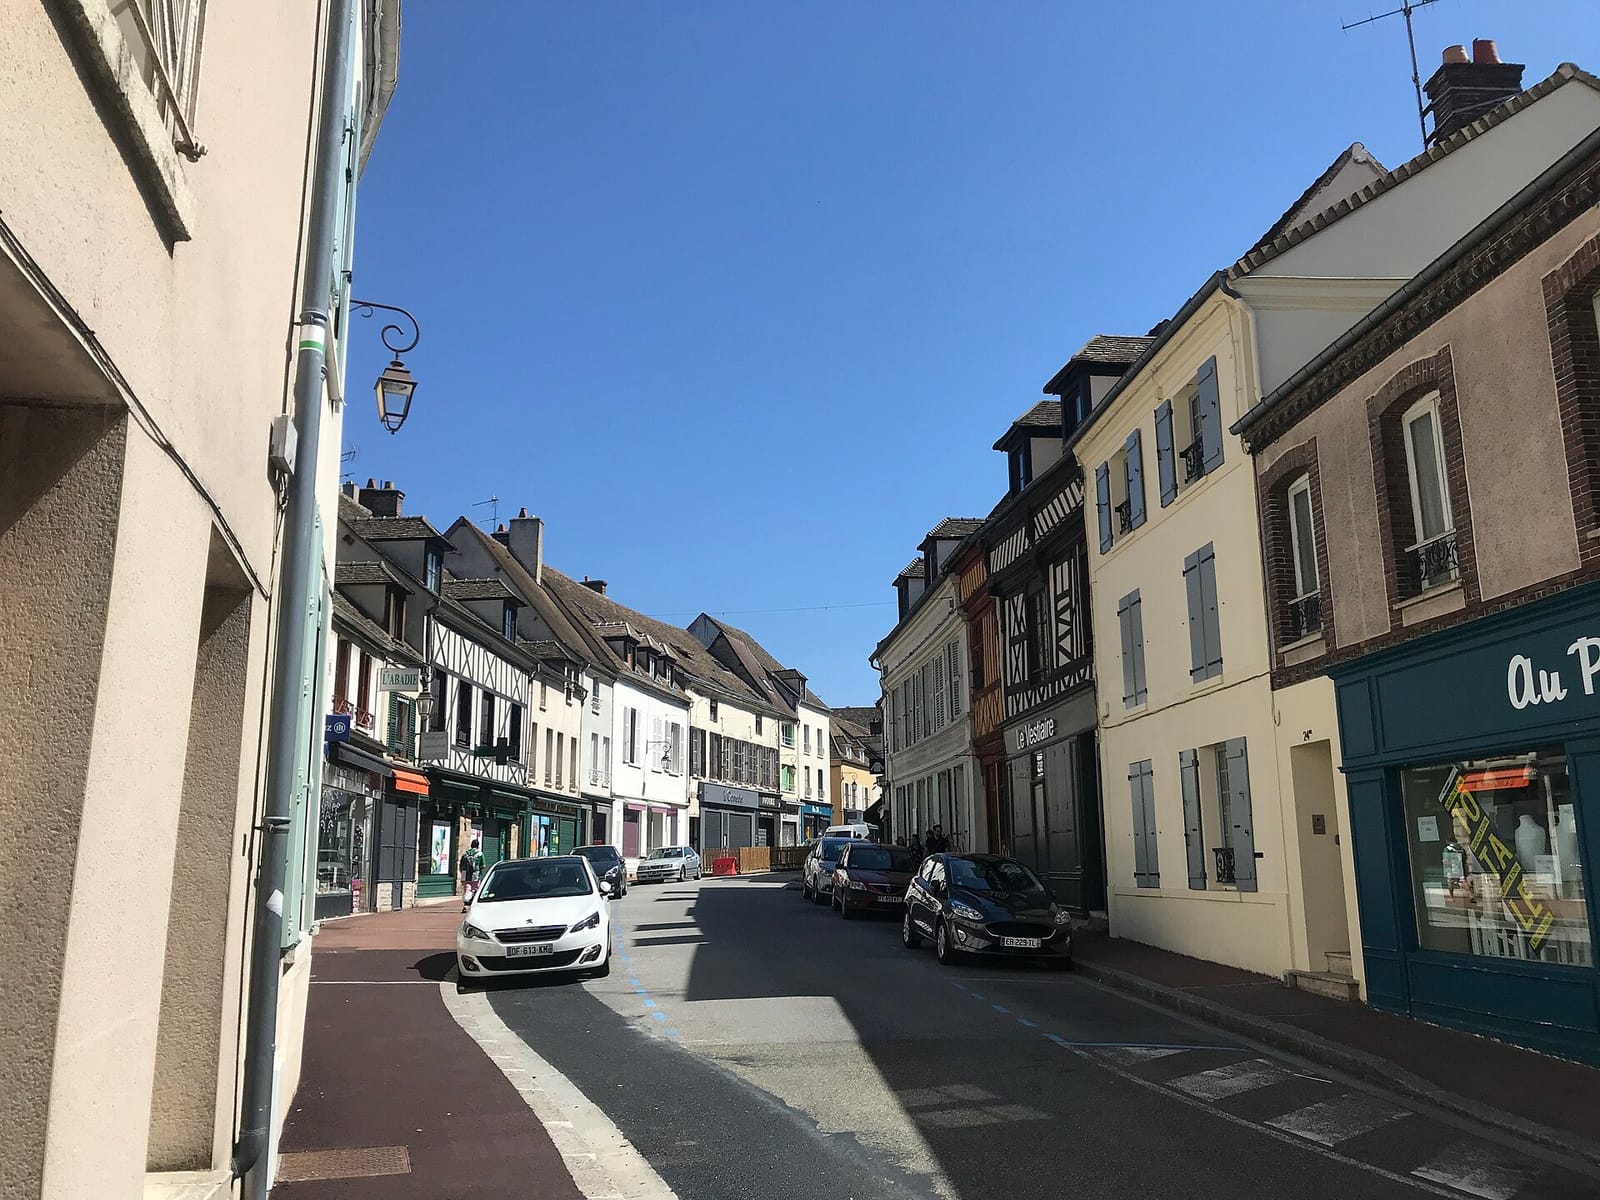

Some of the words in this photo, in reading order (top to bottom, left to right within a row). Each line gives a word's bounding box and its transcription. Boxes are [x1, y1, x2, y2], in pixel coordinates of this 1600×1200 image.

[383, 673, 418, 685] L'ABADIE
[1508, 654, 1568, 710] Au
[1016, 728, 1025, 750] Le
[1025, 717, 1054, 746] Vestiaire
